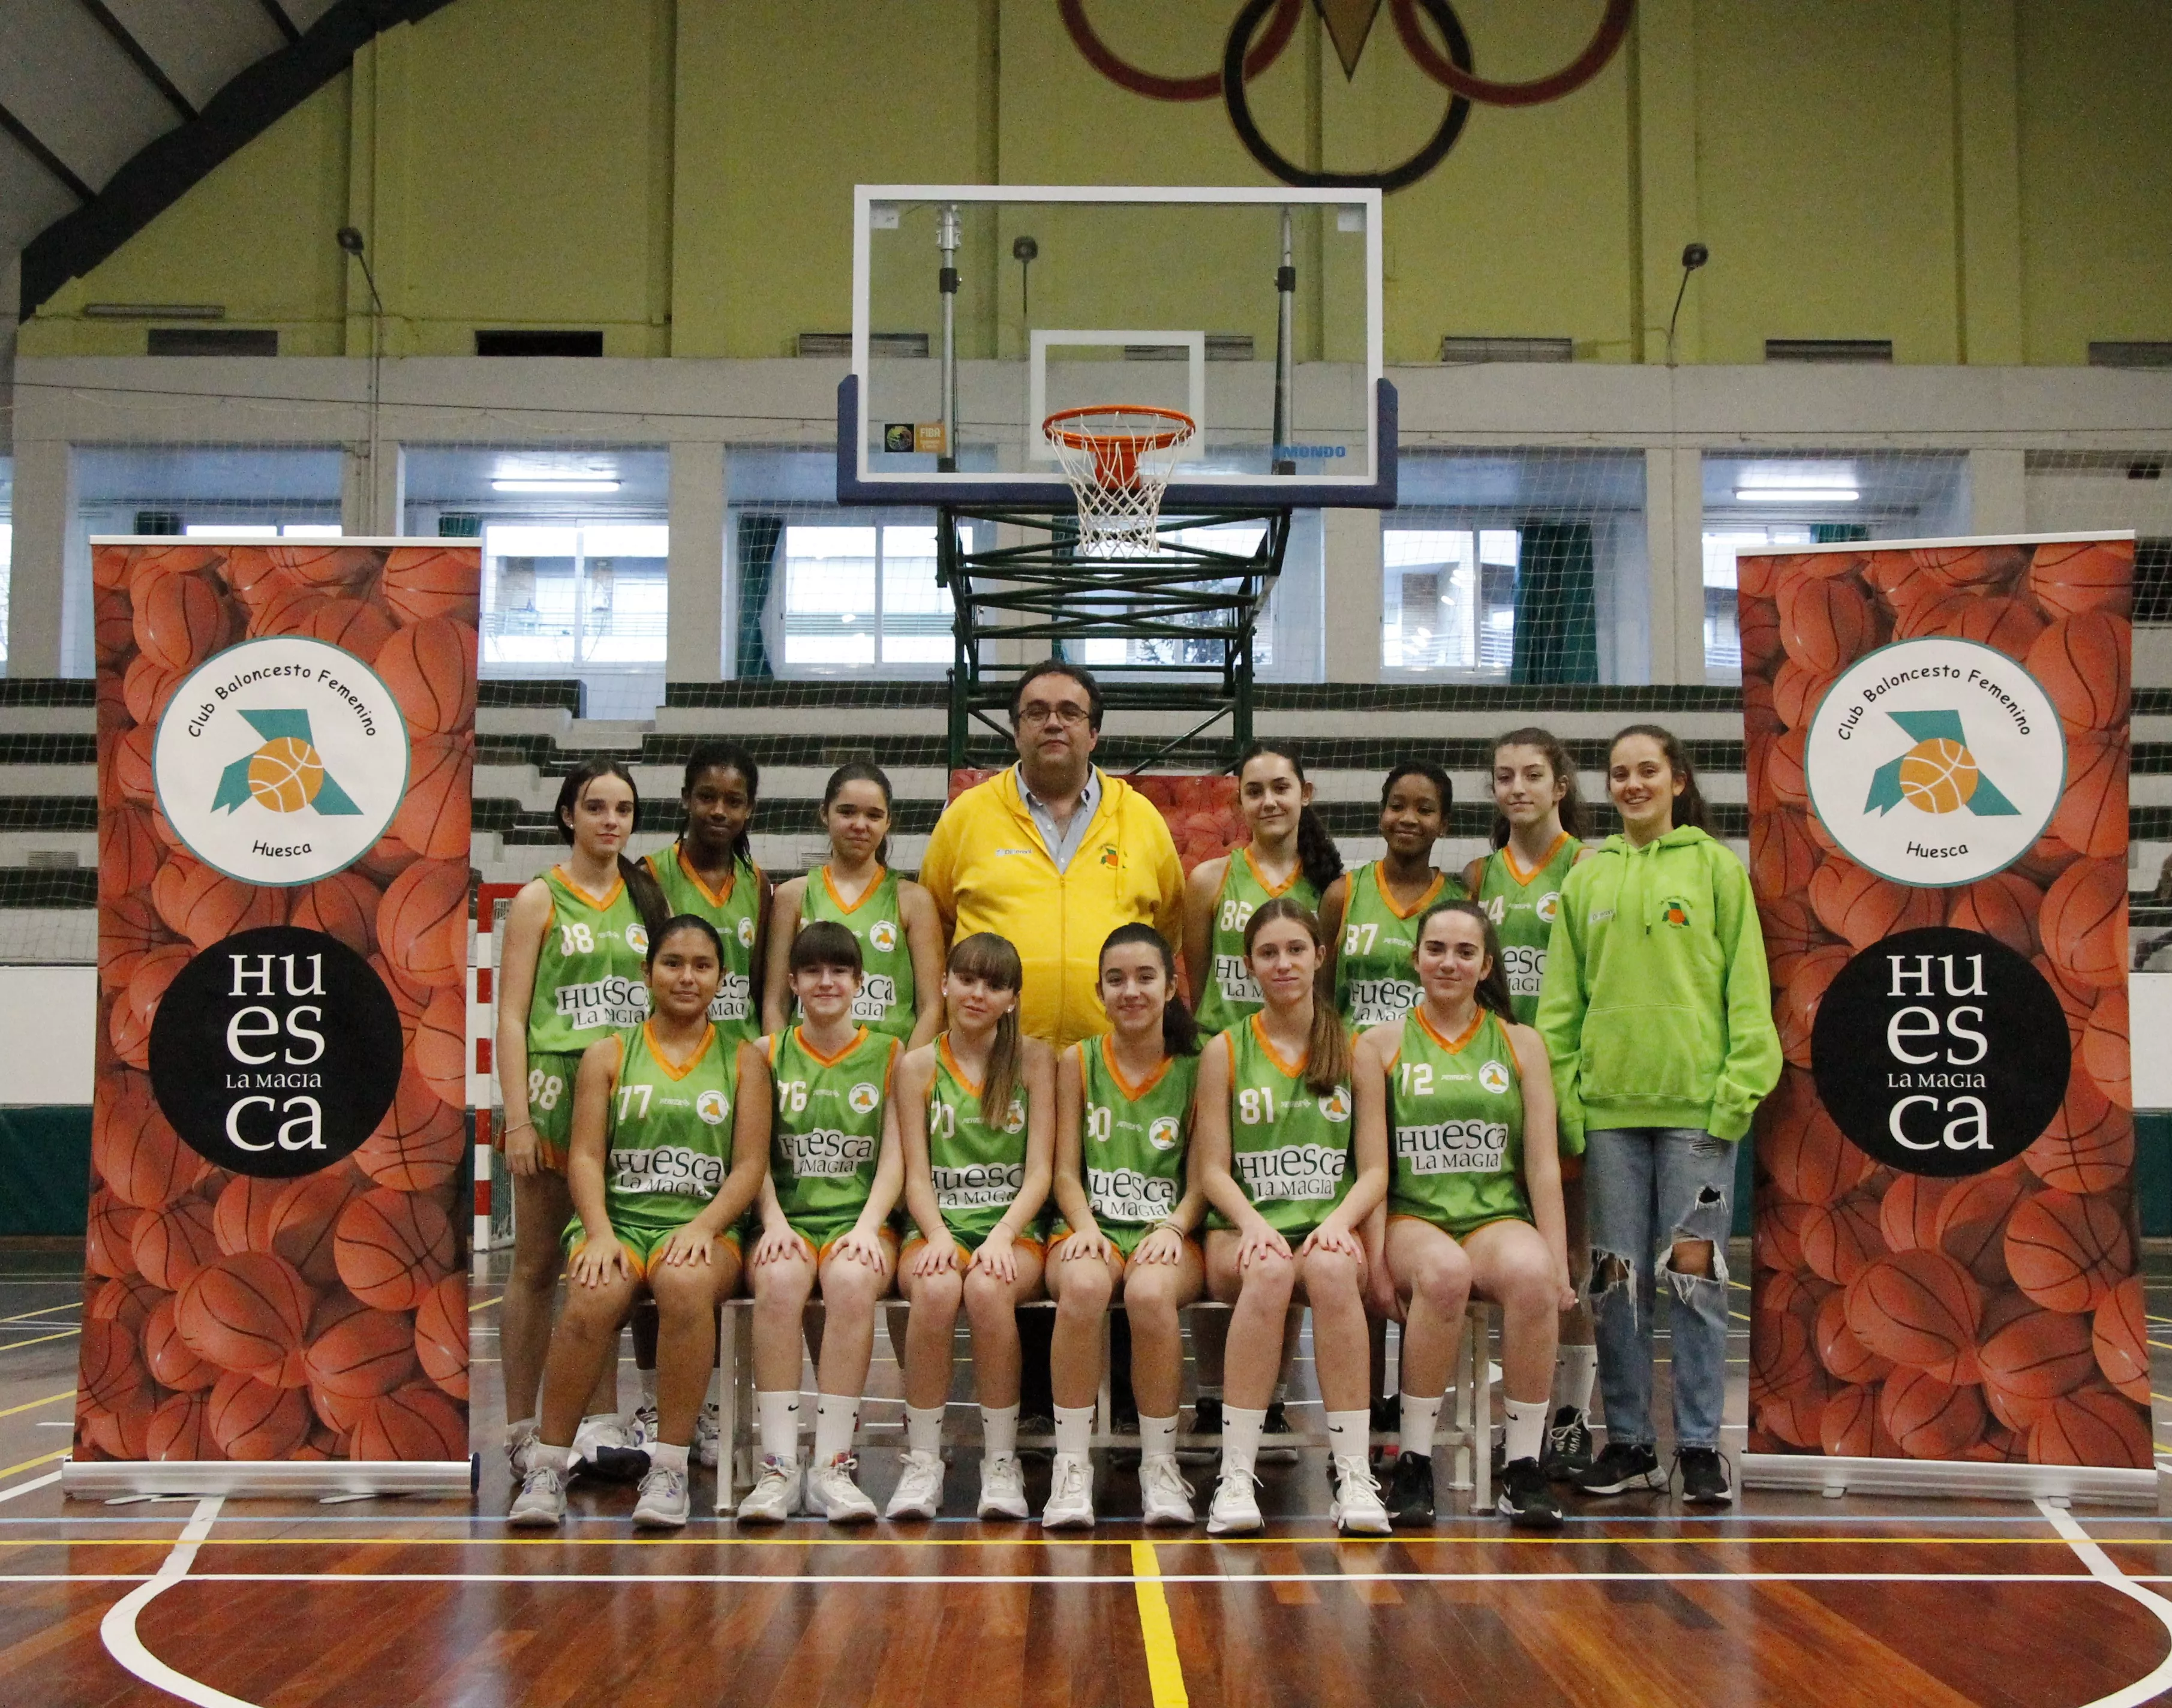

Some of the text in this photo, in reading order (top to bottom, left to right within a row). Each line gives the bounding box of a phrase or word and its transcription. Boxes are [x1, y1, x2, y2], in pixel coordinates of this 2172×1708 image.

[920, 426, 941, 438] FIBA
[1283, 446, 1346, 458] MONDO
[188, 664, 375, 737] Club Baloncesto Femenino
[1838, 665, 2030, 740] Club Baloncesto Femenino
[253, 840, 312, 857] Huesca
[1906, 841, 1968, 858] Huesca
[1220, 900, 1253, 933] 86
[228, 953, 326, 997] Hu
[1886, 954, 1988, 997] Hu
[560, 979, 650, 1011] Huesc
[1350, 982, 1426, 1008] Huesc
[226, 1006, 325, 1065] es
[1887, 1006, 1988, 1065] es
[618, 1084, 653, 1120] 77
[777, 1079, 807, 1112] 76
[1239, 1087, 1274, 1125] 81
[226, 1096, 327, 1151] ca
[930, 1100, 955, 1139] 70
[1889, 1094, 1994, 1150] ca
[1397, 1124, 1507, 1153] Huesca
[613, 1149, 722, 1183] Huesca
[932, 1167, 1026, 1190] Huesc
[1238, 1148, 1347, 1179] Huesca
[1089, 1172, 1175, 1202] uesca
